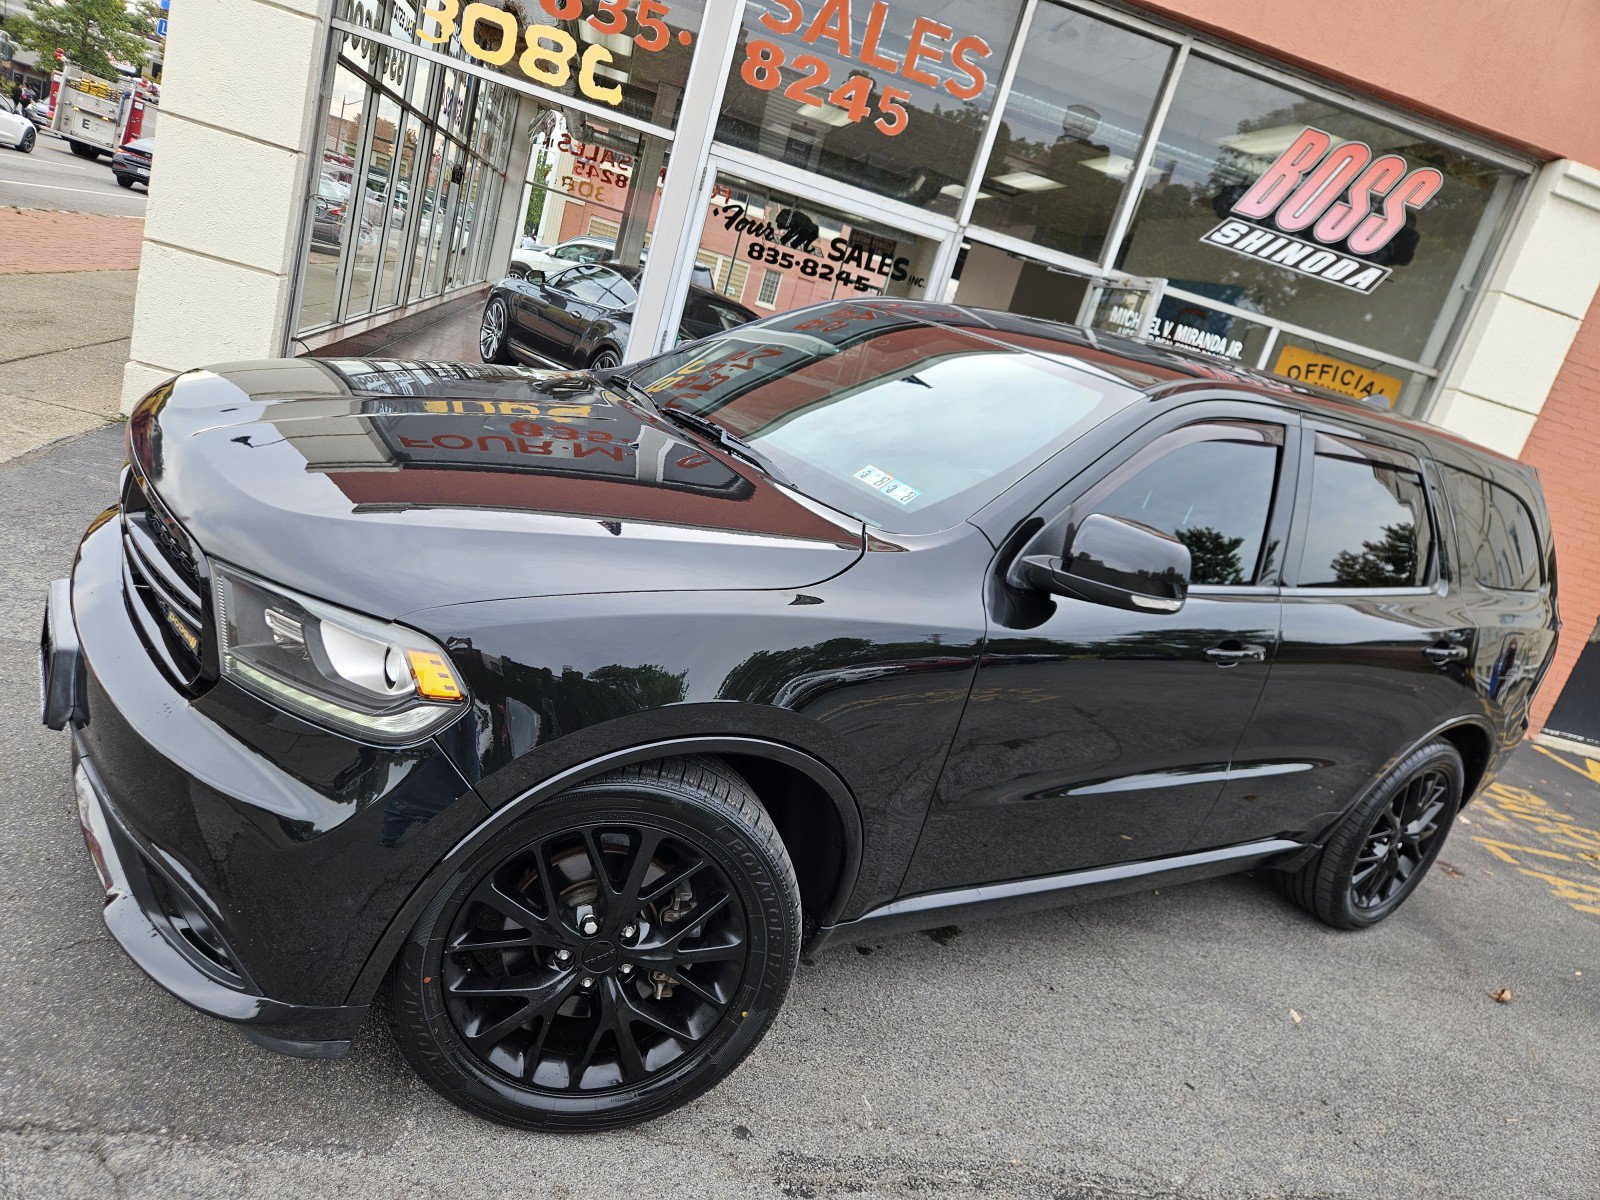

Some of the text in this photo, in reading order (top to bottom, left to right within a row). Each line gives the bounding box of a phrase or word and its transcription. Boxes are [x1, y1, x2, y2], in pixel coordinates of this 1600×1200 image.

[741, 40, 912, 136] 8245
[757, 0, 993, 101] SALES
[1230, 126, 1443, 255] BOSS
[722, 204, 776, 242] Four
[828, 237, 910, 282] SALES
[1210, 220, 1386, 291] SHINODA
[1109, 306, 1161, 335] MICHEL
[1173, 323, 1228, 355] MIRANDA
